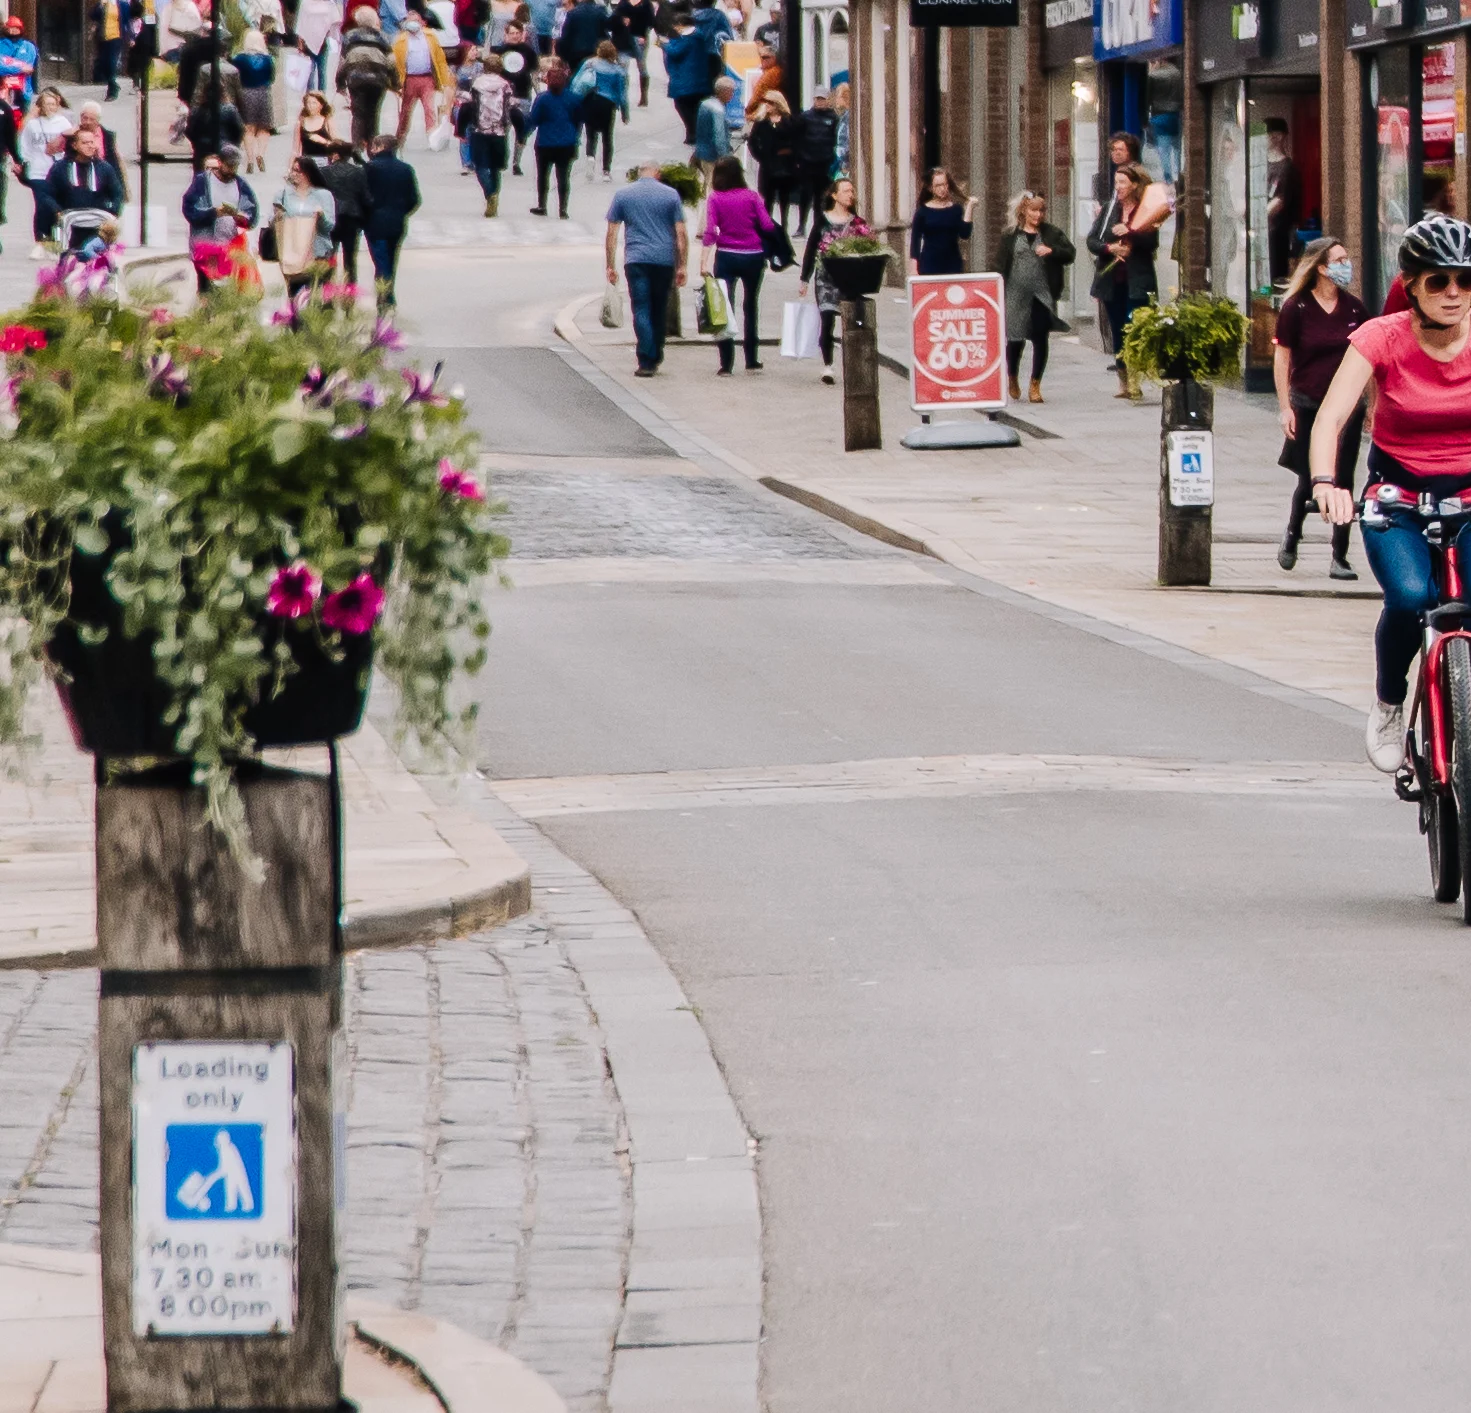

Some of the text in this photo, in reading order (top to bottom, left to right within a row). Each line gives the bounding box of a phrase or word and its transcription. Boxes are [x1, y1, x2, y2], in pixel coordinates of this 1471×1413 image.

[929, 307, 986, 320] SUMMER
[927, 320, 987, 342] SALE
[160, 1055, 270, 1083] Loading
[185, 1086, 244, 1113] only
[150, 1237, 209, 1260] Mon
